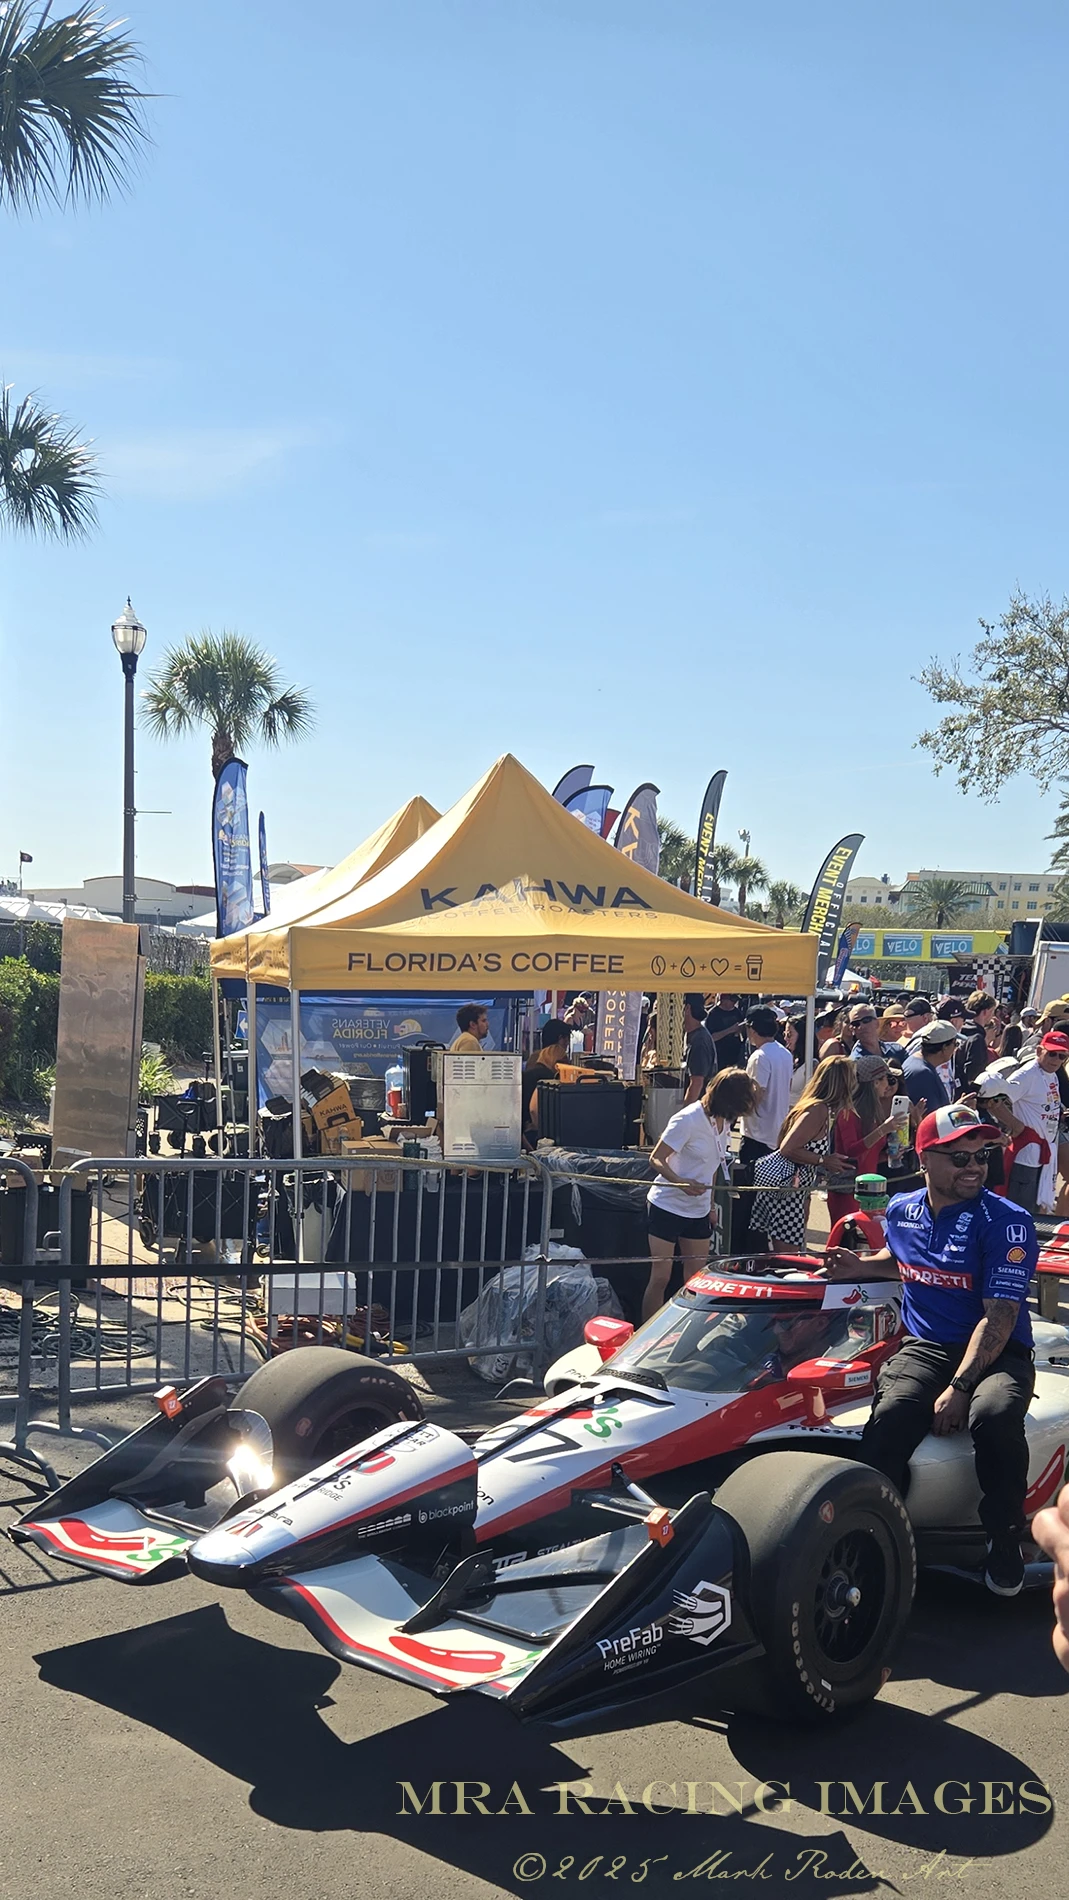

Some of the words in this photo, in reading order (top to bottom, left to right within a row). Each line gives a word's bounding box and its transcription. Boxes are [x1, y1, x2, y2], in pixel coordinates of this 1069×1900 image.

[700, 813, 714, 856] EVENT
[822, 847, 853, 887] EVENT
[420, 878, 653, 910] KAHWA
[534, 904, 658, 919] ROASTERS
[818, 882, 844, 956] OFFICIAL
[887, 940, 918, 953] VELO
[936, 941, 968, 953] VELO
[347, 953, 502, 972] FLORIDA'S
[511, 953, 624, 973] COFFEE
[319, 1103, 347, 1117] KAHWA
[897, 1221, 925, 1230] HONDA
[899, 1267, 968, 1289] NDRETTI
[998, 1267, 1026, 1276] SIEMENS
[848, 1374, 869, 1383] SIEMENS
[429, 1501, 474, 1520] blackpoint
[596, 1623, 663, 1659] PreFab
[604, 1656, 626, 1671] HOME
